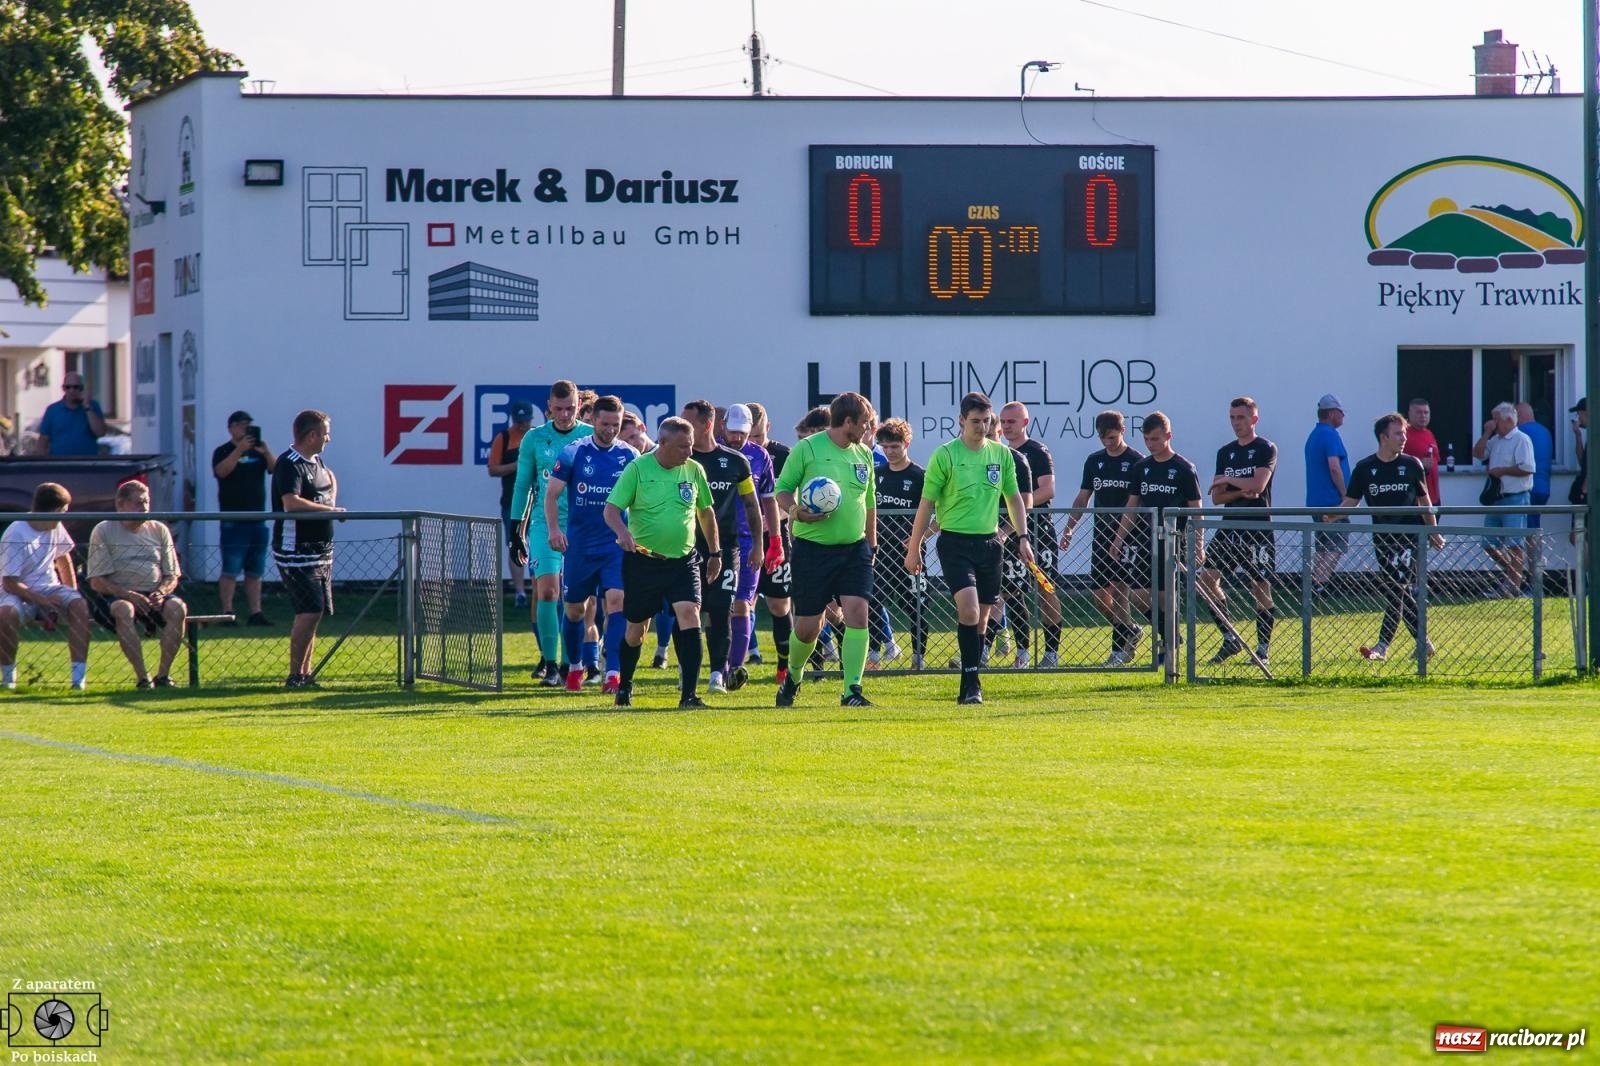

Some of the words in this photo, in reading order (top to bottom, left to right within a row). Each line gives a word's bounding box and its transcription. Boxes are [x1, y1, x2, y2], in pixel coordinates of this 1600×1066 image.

[835, 155, 893, 170] BORUCIN
[1078, 152, 1125, 171] GOŚCIE
[385, 167, 522, 203] Marek
[533, 167, 568, 203] &
[585, 168, 739, 204] Dariusz
[848, 173, 881, 247] 0
[967, 205, 1000, 220] CZAS
[1085, 173, 1118, 247] 0
[465, 225, 626, 245] Metallbau
[654, 225, 740, 245] GmbH
[1377, 281, 1465, 315] Piękny
[1475, 281, 1584, 306] Trawnik
[921, 360, 1070, 406] HIMEL
[1076, 359, 1158, 413] JOB
[922, 416, 961, 439] PR
[1102, 479, 1132, 489] SPORT
[1148, 483, 1178, 495] SPORT
[1379, 482, 1410, 493] SPORT
[883, 494, 913, 508] SPORT
[771, 562, 793, 583] 22
